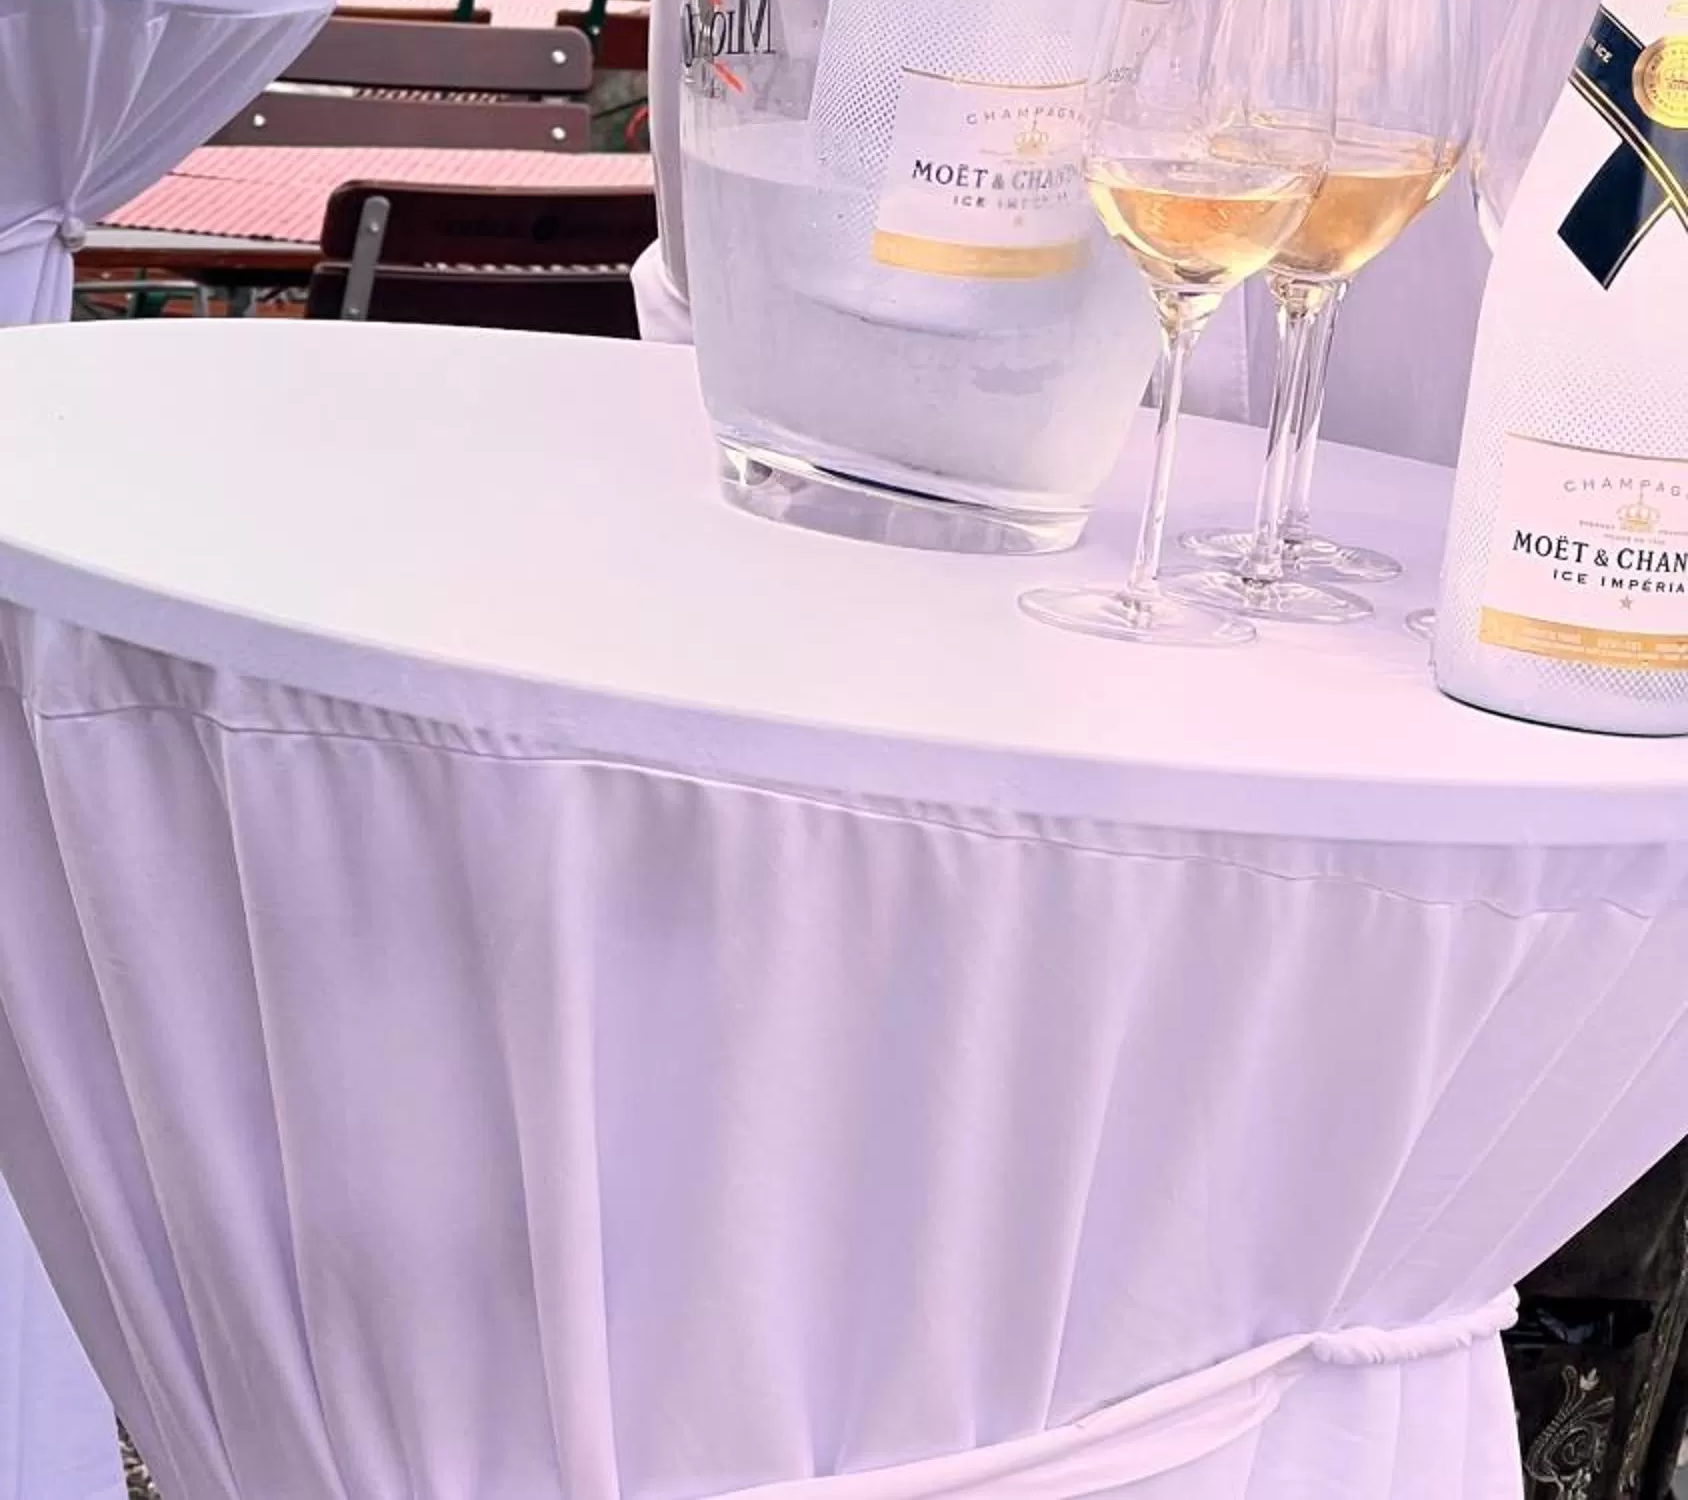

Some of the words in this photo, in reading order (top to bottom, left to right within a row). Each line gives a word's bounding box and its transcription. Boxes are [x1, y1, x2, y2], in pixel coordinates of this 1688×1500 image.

[912, 159, 989, 189] MOËT
[953, 194, 987, 208] ICE
[1563, 477, 1688, 500] CHAMPAG
[1512, 529, 1589, 564] MOËT
[1593, 547, 1609, 567] &
[1553, 568, 1589, 585] ICE
[1600, 575, 1686, 594] IMPÉRIA
